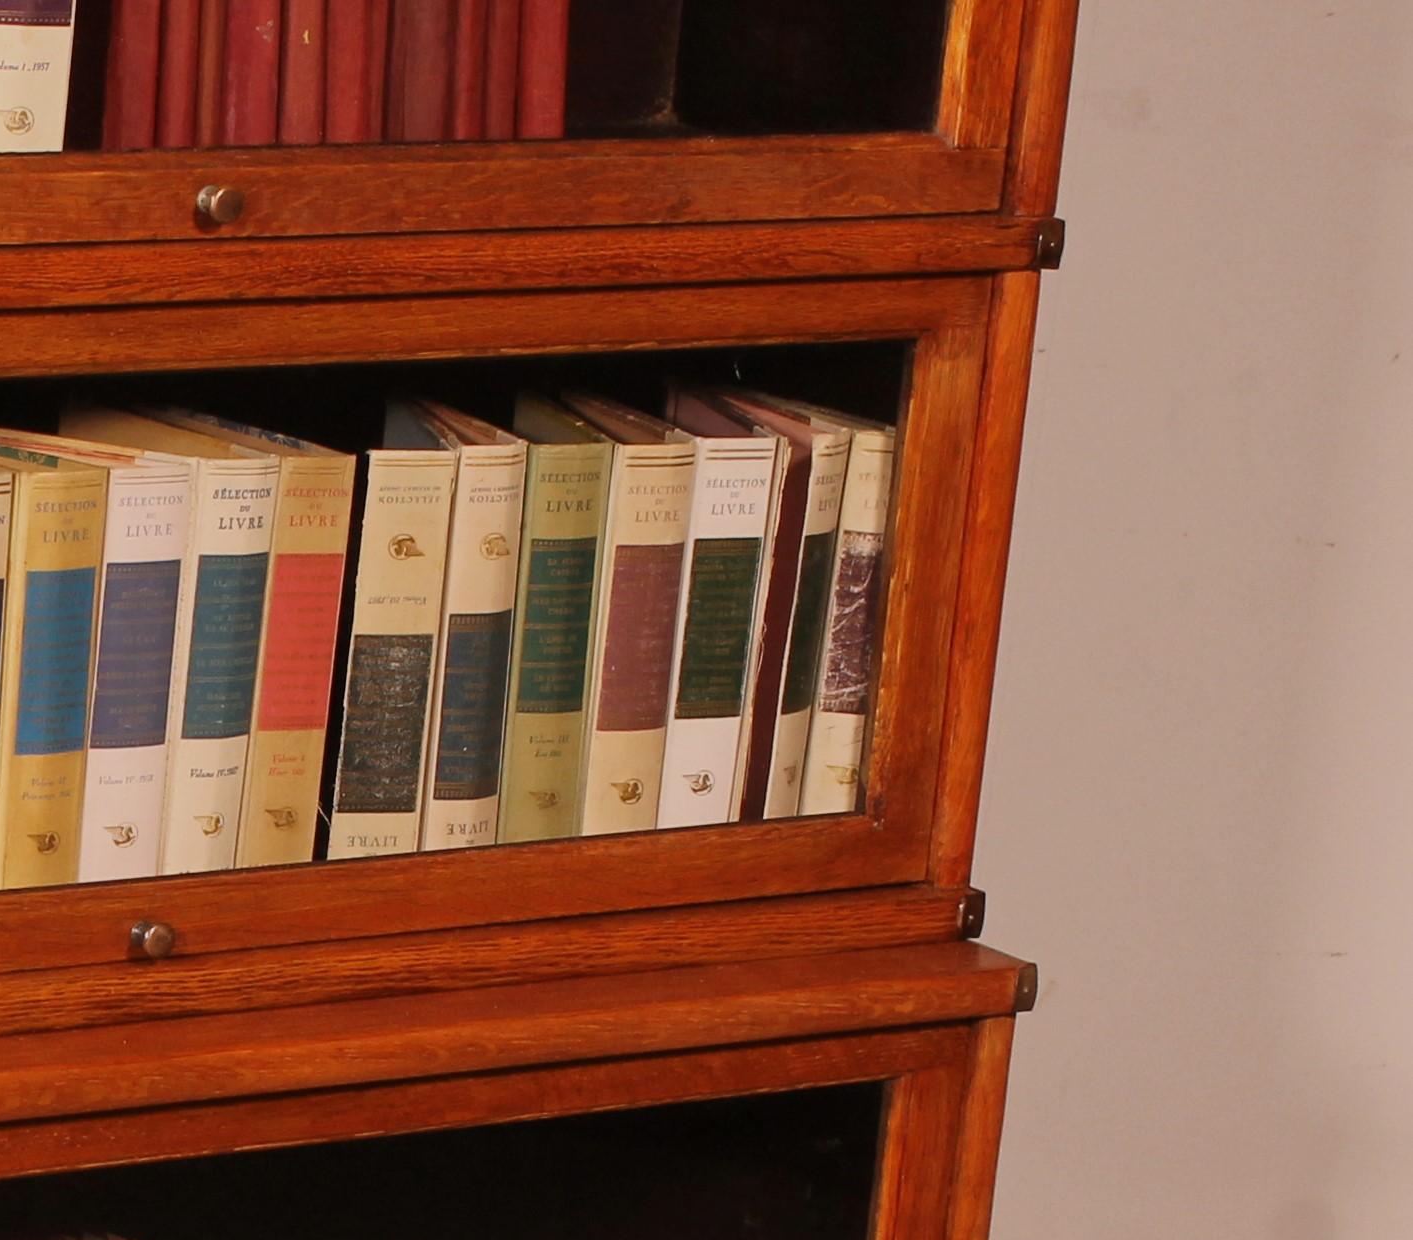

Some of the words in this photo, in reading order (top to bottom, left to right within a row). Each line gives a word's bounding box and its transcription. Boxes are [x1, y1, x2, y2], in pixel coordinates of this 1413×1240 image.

[539, 472, 601, 484] SÉLECTION
[706, 477, 767, 489] SÉLECTION
[212, 487, 273, 500] SÉLECTION
[285, 485, 347, 498] SÉLECTION
[35, 500, 97, 513] SÉLECTION
[117, 495, 183, 508] SÉLECTION
[546, 499, 593, 513] LIVRE
[239, 505, 251, 513] DU
[711, 502, 756, 516] LIVRE
[218, 516, 264, 530] LIVRE
[290, 515, 337, 528] LIVRE
[635, 510, 680, 523] LIVRE
[43, 528, 91, 543] LIVRE
[126, 523, 173, 538] LIVRE
[189, 768, 215, 778] Volume
[446, 820, 489, 835] LIVRE
[347, 835, 399, 848] LIVRE
